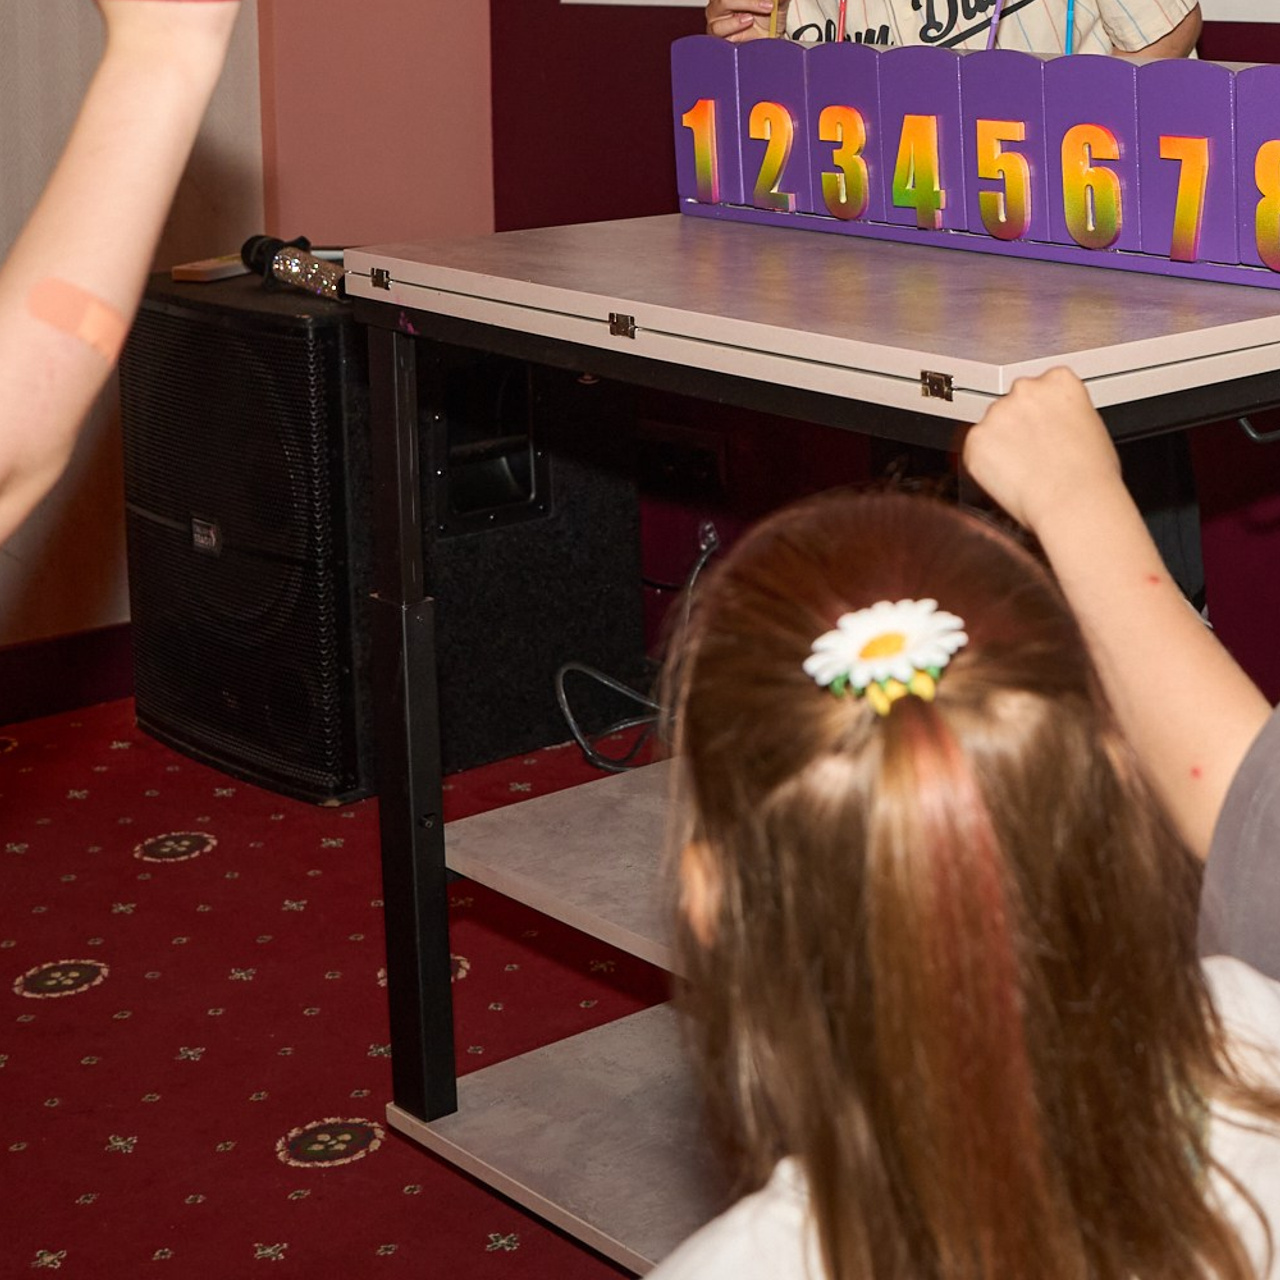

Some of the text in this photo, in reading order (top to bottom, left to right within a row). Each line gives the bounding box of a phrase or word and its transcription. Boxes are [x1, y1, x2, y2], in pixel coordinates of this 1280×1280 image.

[682, 98, 720, 205] 1
[749, 100, 796, 214] 2
[818, 104, 870, 221] 3
[892, 113, 946, 231] 4
[976, 119, 1032, 241] 5
[1061, 122, 1123, 250] 6
[1158, 134, 1210, 263] 7
